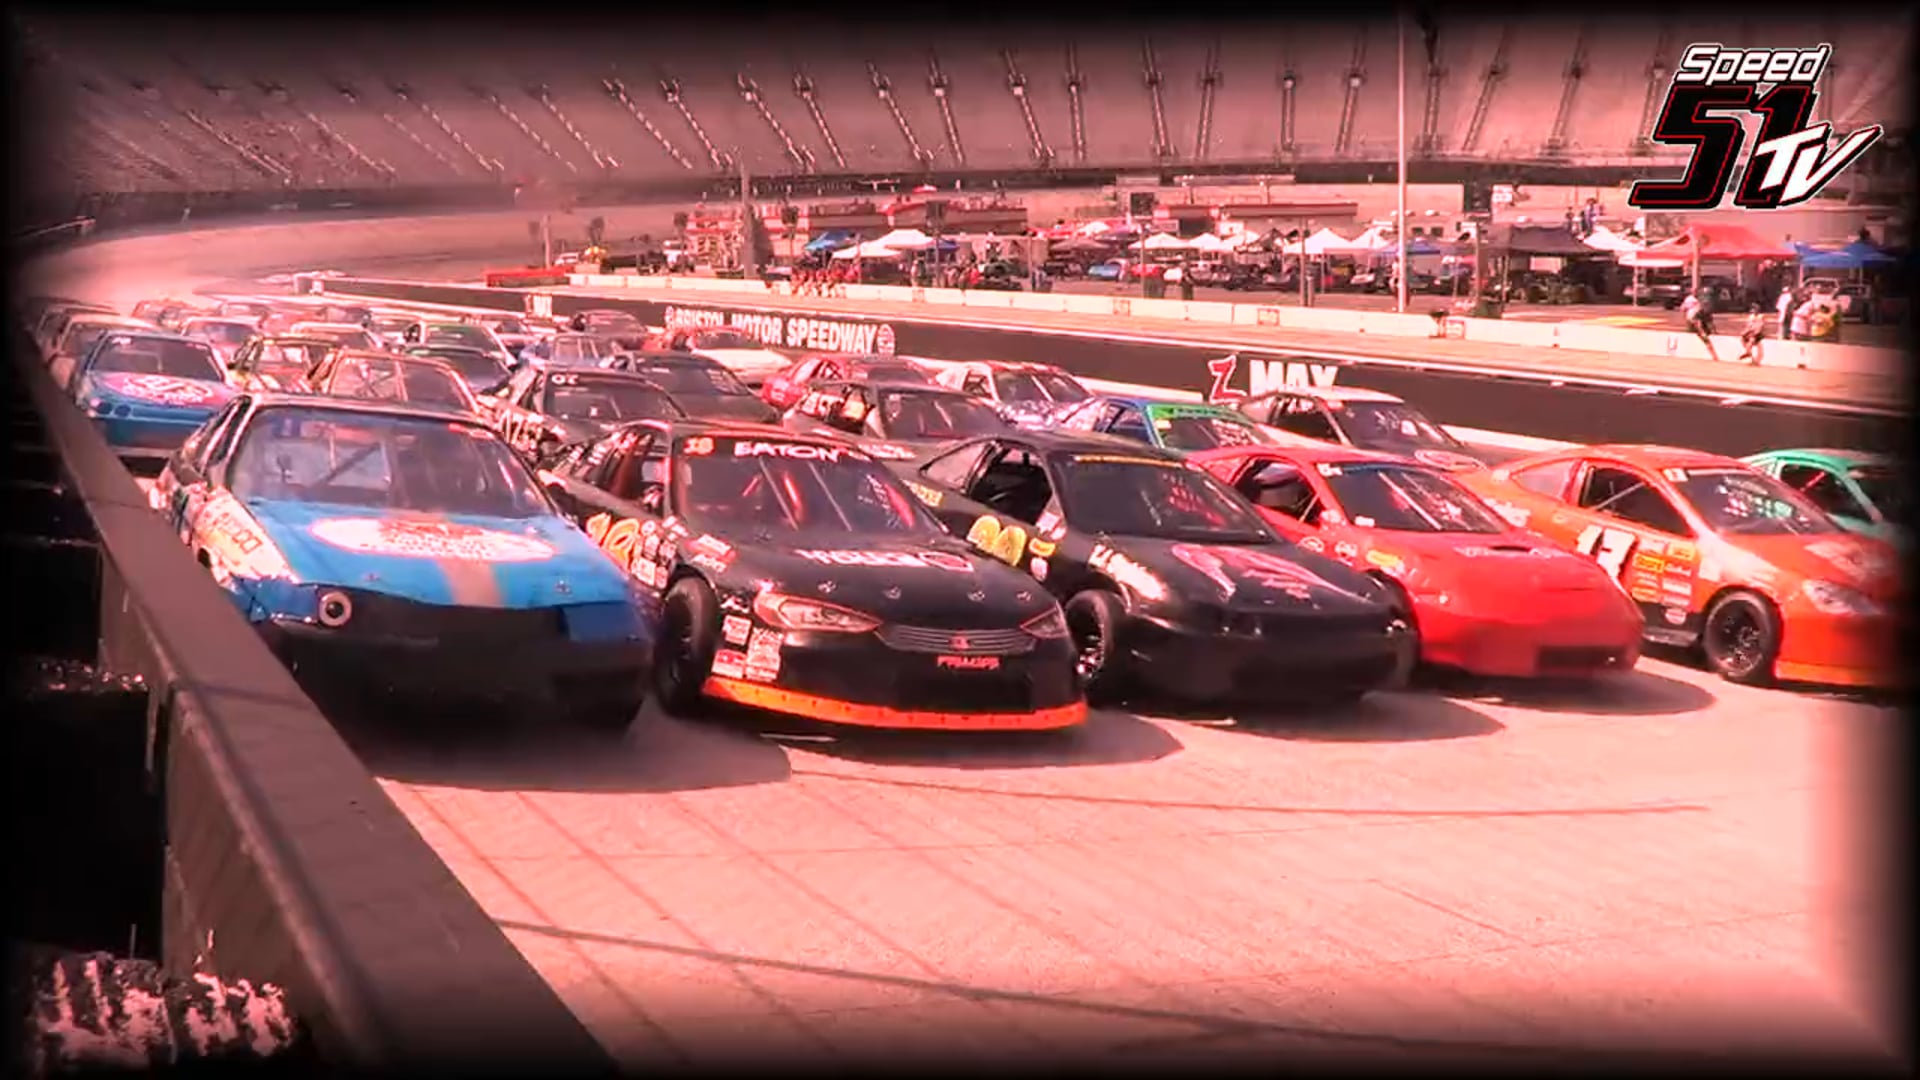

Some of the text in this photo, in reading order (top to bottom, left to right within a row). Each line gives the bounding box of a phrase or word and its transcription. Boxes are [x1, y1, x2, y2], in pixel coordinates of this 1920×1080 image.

[732, 312, 783, 345] MOTOR
[786, 318, 877, 353] SPEEDWAY
[734, 441, 840, 463] EATON
